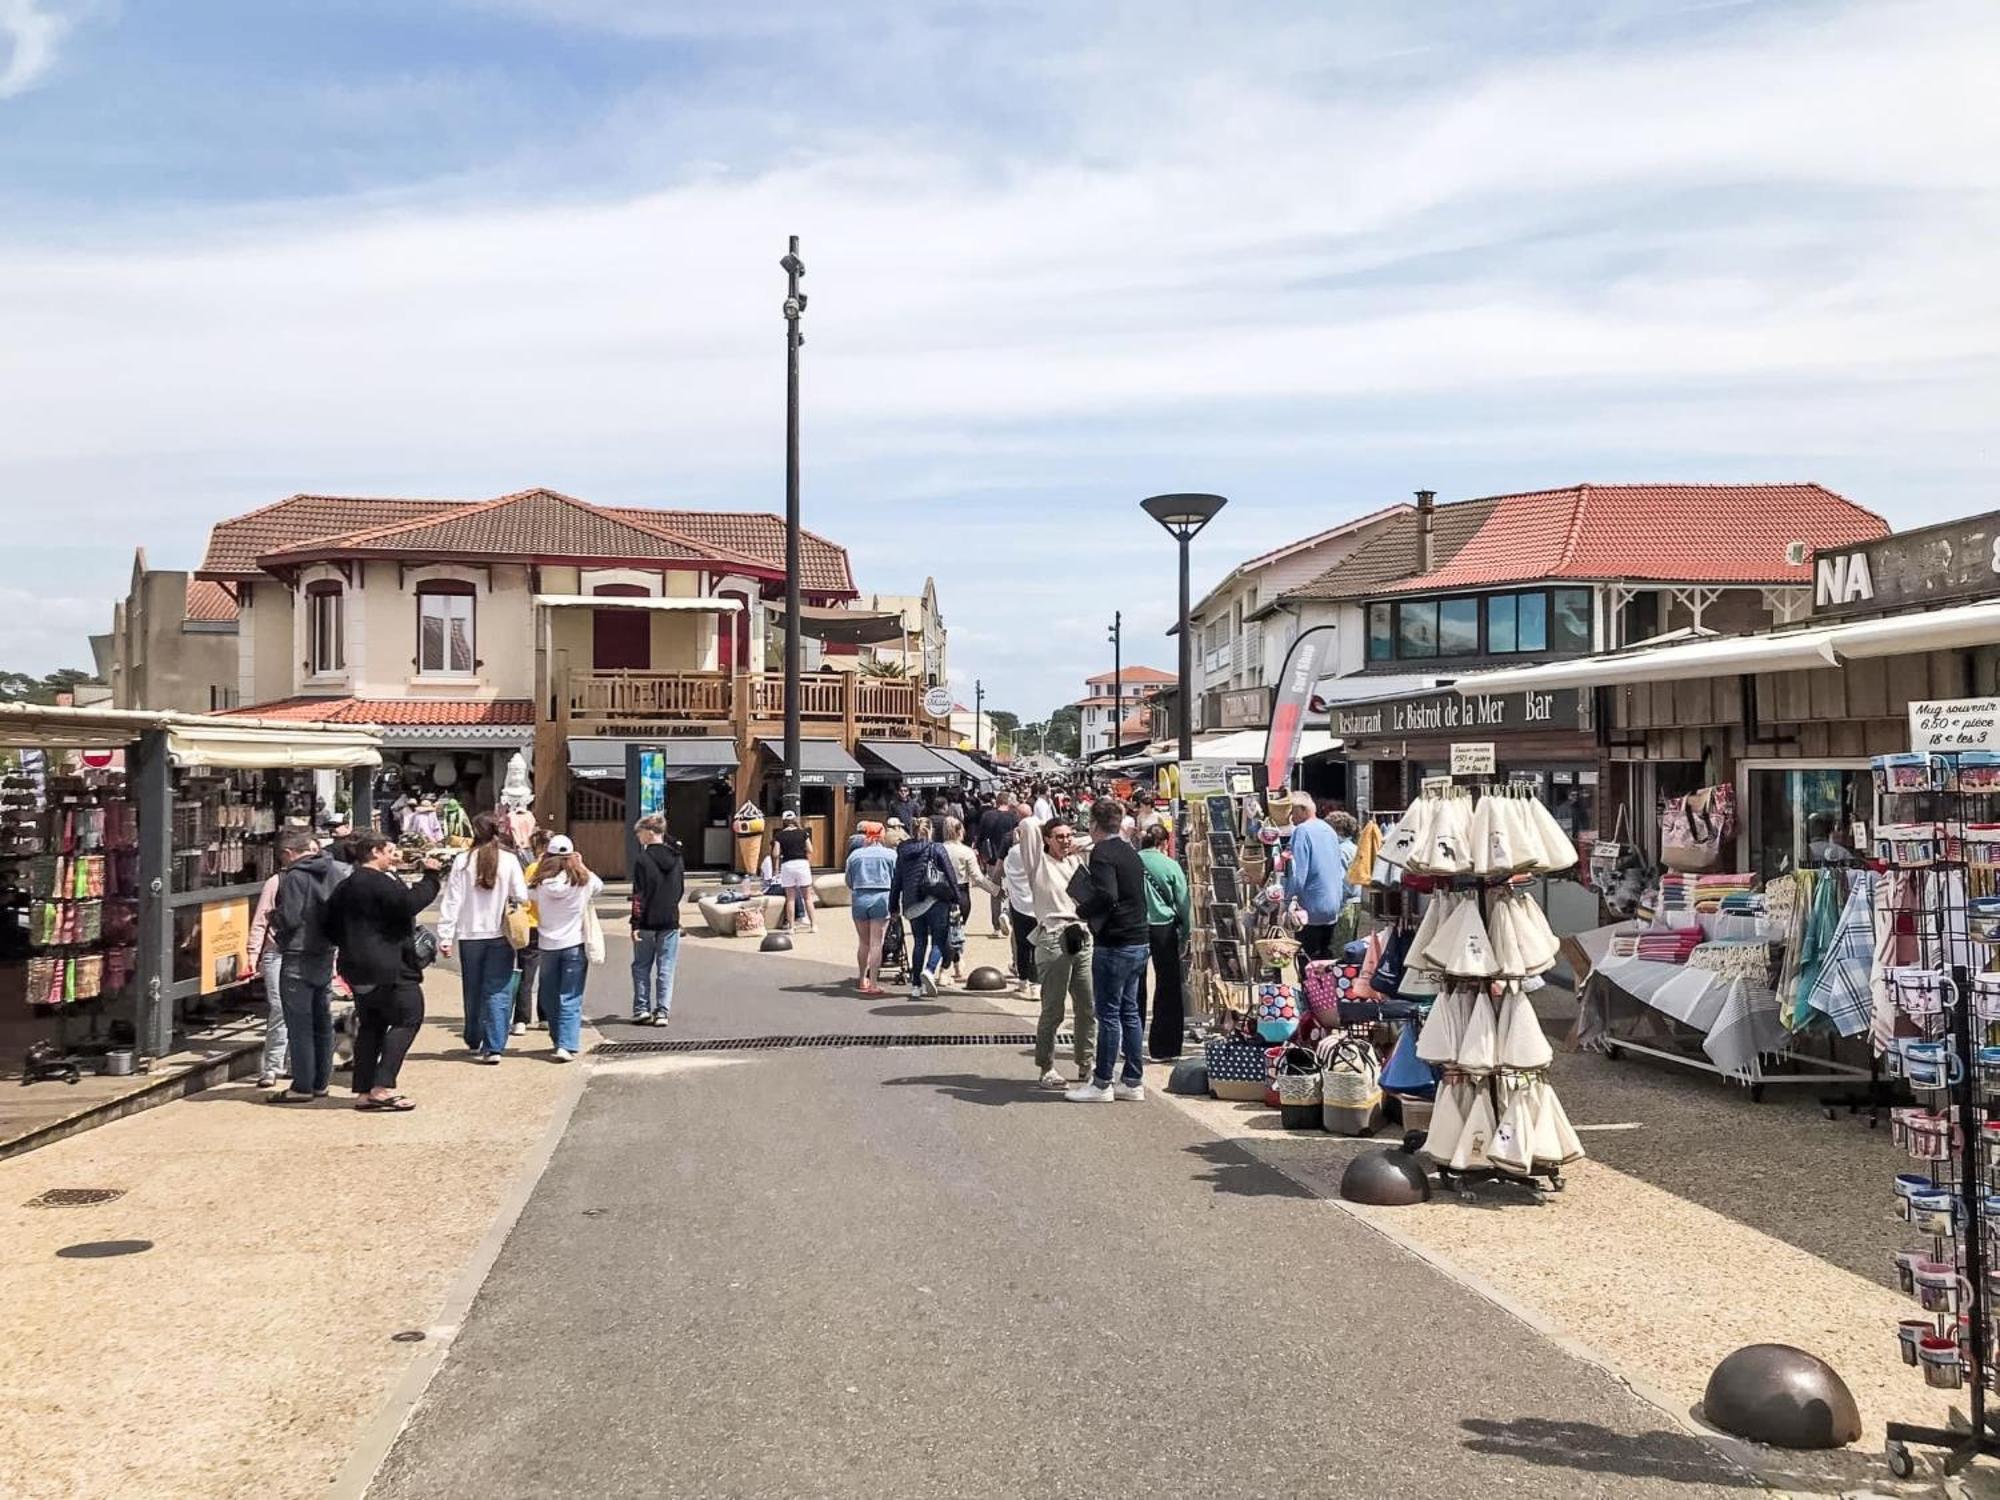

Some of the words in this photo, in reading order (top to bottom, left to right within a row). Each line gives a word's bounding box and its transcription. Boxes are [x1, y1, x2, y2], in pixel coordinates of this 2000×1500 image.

[1816, 553, 1874, 606] NA
[1339, 708, 1381, 733] Restaurant
[1392, 706, 1405, 730] Le
[1406, 703, 1441, 729] Bistrot
[1444, 698, 1459, 726] de
[1462, 695, 1473, 725] la
[1477, 695, 1505, 724] Mer
[1525, 691, 1553, 720] Bar
[1916, 704, 1943, 719] Mug
[1946, 702, 1997, 713] souvenir
[596, 726, 607, 736] LA
[609, 726, 654, 736] TERRASSE
[656, 726, 670, 736] DU
[672, 726, 708, 736] GLACIER
[1929, 733, 1943, 745] 18
[1956, 732, 1974, 744] les
[1977, 731, 1988, 743] 3
